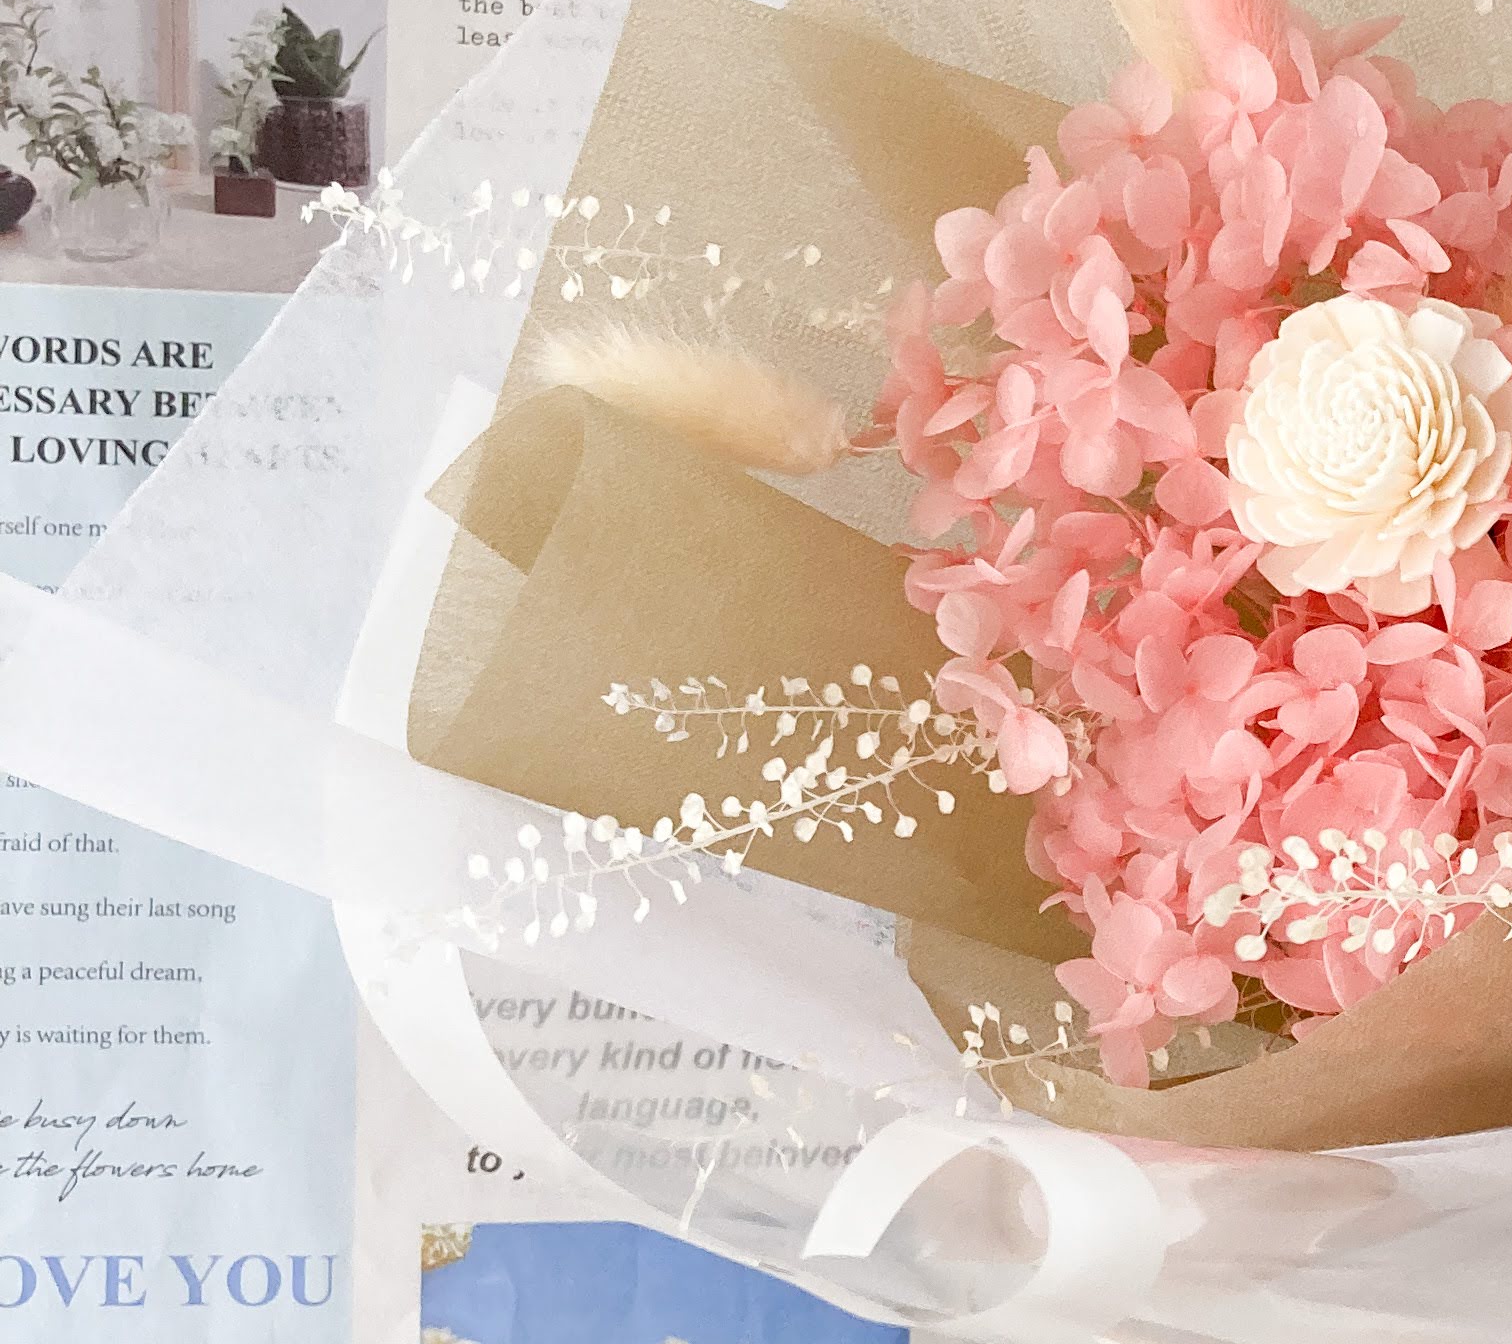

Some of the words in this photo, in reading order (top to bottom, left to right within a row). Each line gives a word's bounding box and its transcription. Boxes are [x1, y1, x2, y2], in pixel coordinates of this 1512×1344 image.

[0, 335, 121, 367] ORDS
[131, 340, 214, 369] ARE
[11, 434, 170, 468] LOVING
[44, 522, 83, 537] one
[48, 832, 73, 853] of
[75, 833, 120, 854] that.
[40, 901, 90, 923] sung
[96, 896, 144, 918] their
[149, 898, 182, 919] last
[187, 902, 237, 924] song
[21, 966, 32, 980] a
[39, 959, 125, 986] peaceful
[130, 961, 204, 983] dream,
[16, 1024, 32, 1044] is
[37, 1024, 113, 1050] waiting
[118, 1024, 148, 1045] for
[153, 1025, 212, 1046] them.
[601, 1040, 684, 1071] kind
[692, 1043, 732, 1071] of
[23, 1098, 97, 1152] busy
[105, 1100, 189, 1130] down
[467, 1145, 503, 1174] to
[13, 1150, 65, 1178] the
[58, 1148, 175, 1202] flowers
[186, 1150, 265, 1178] home
[169, 1254, 337, 1308] YOU
